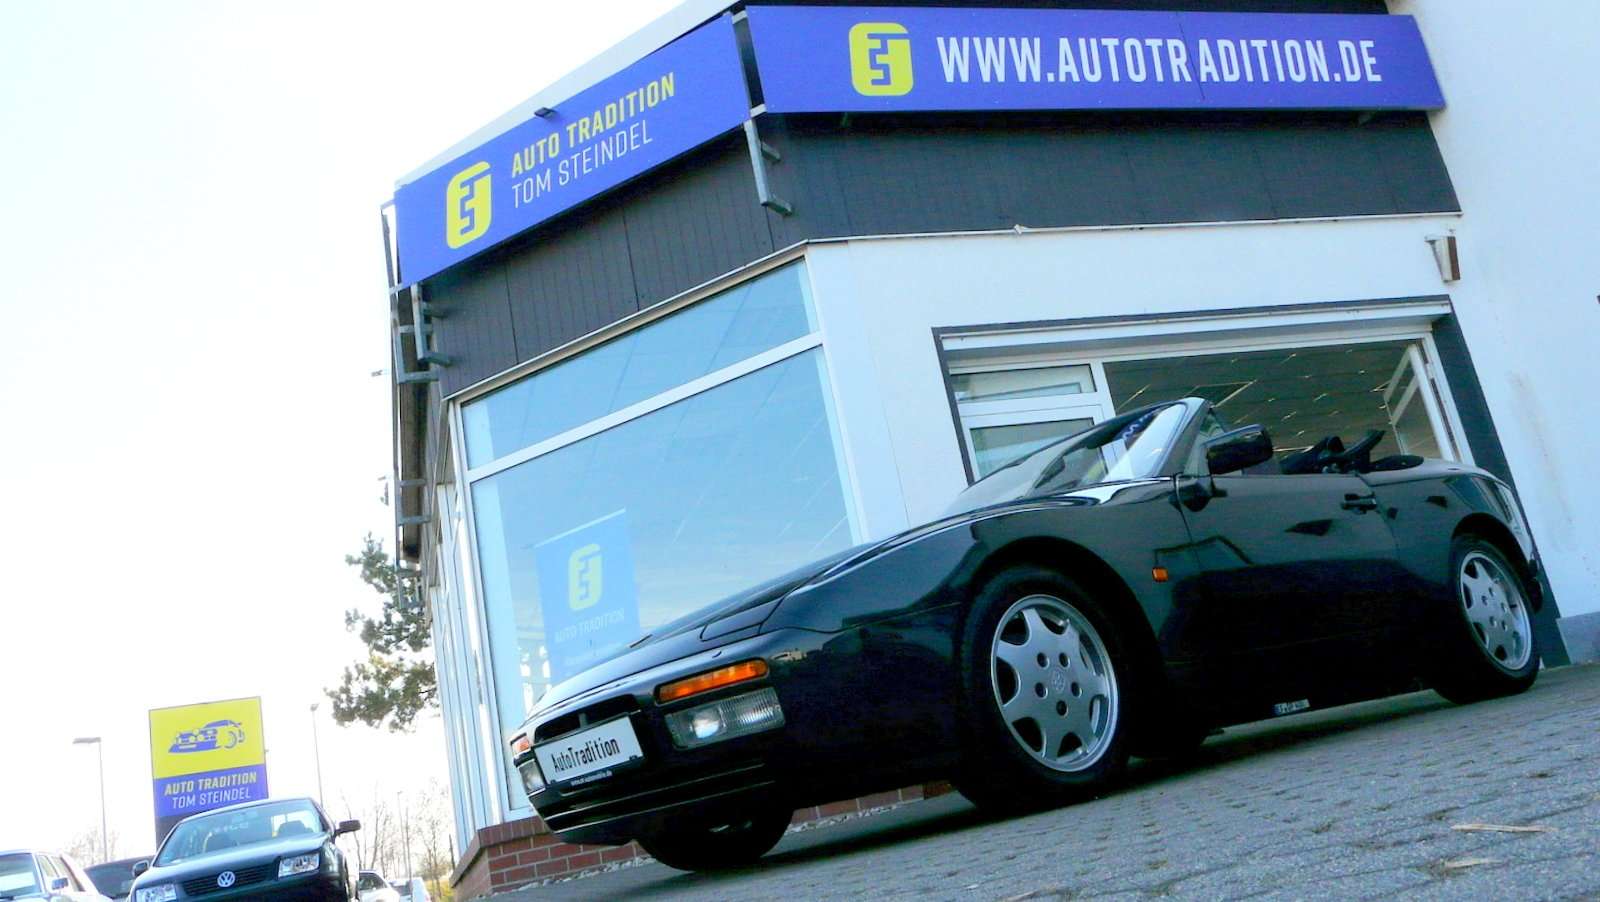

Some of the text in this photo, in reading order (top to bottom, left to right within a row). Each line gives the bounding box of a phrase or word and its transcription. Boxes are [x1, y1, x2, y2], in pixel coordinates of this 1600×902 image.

[936, 36, 1382, 83] WWW.AUTOTRADITION.DE
[511, 72, 676, 178] AUTO TRADITION
[511, 119, 654, 209] TOM STEINDEL
[552, 737, 620, 773] AutoTradition
[164, 771, 257, 796] AUTO TRADITION
[172, 787, 251, 809] TOM STEINDEL
